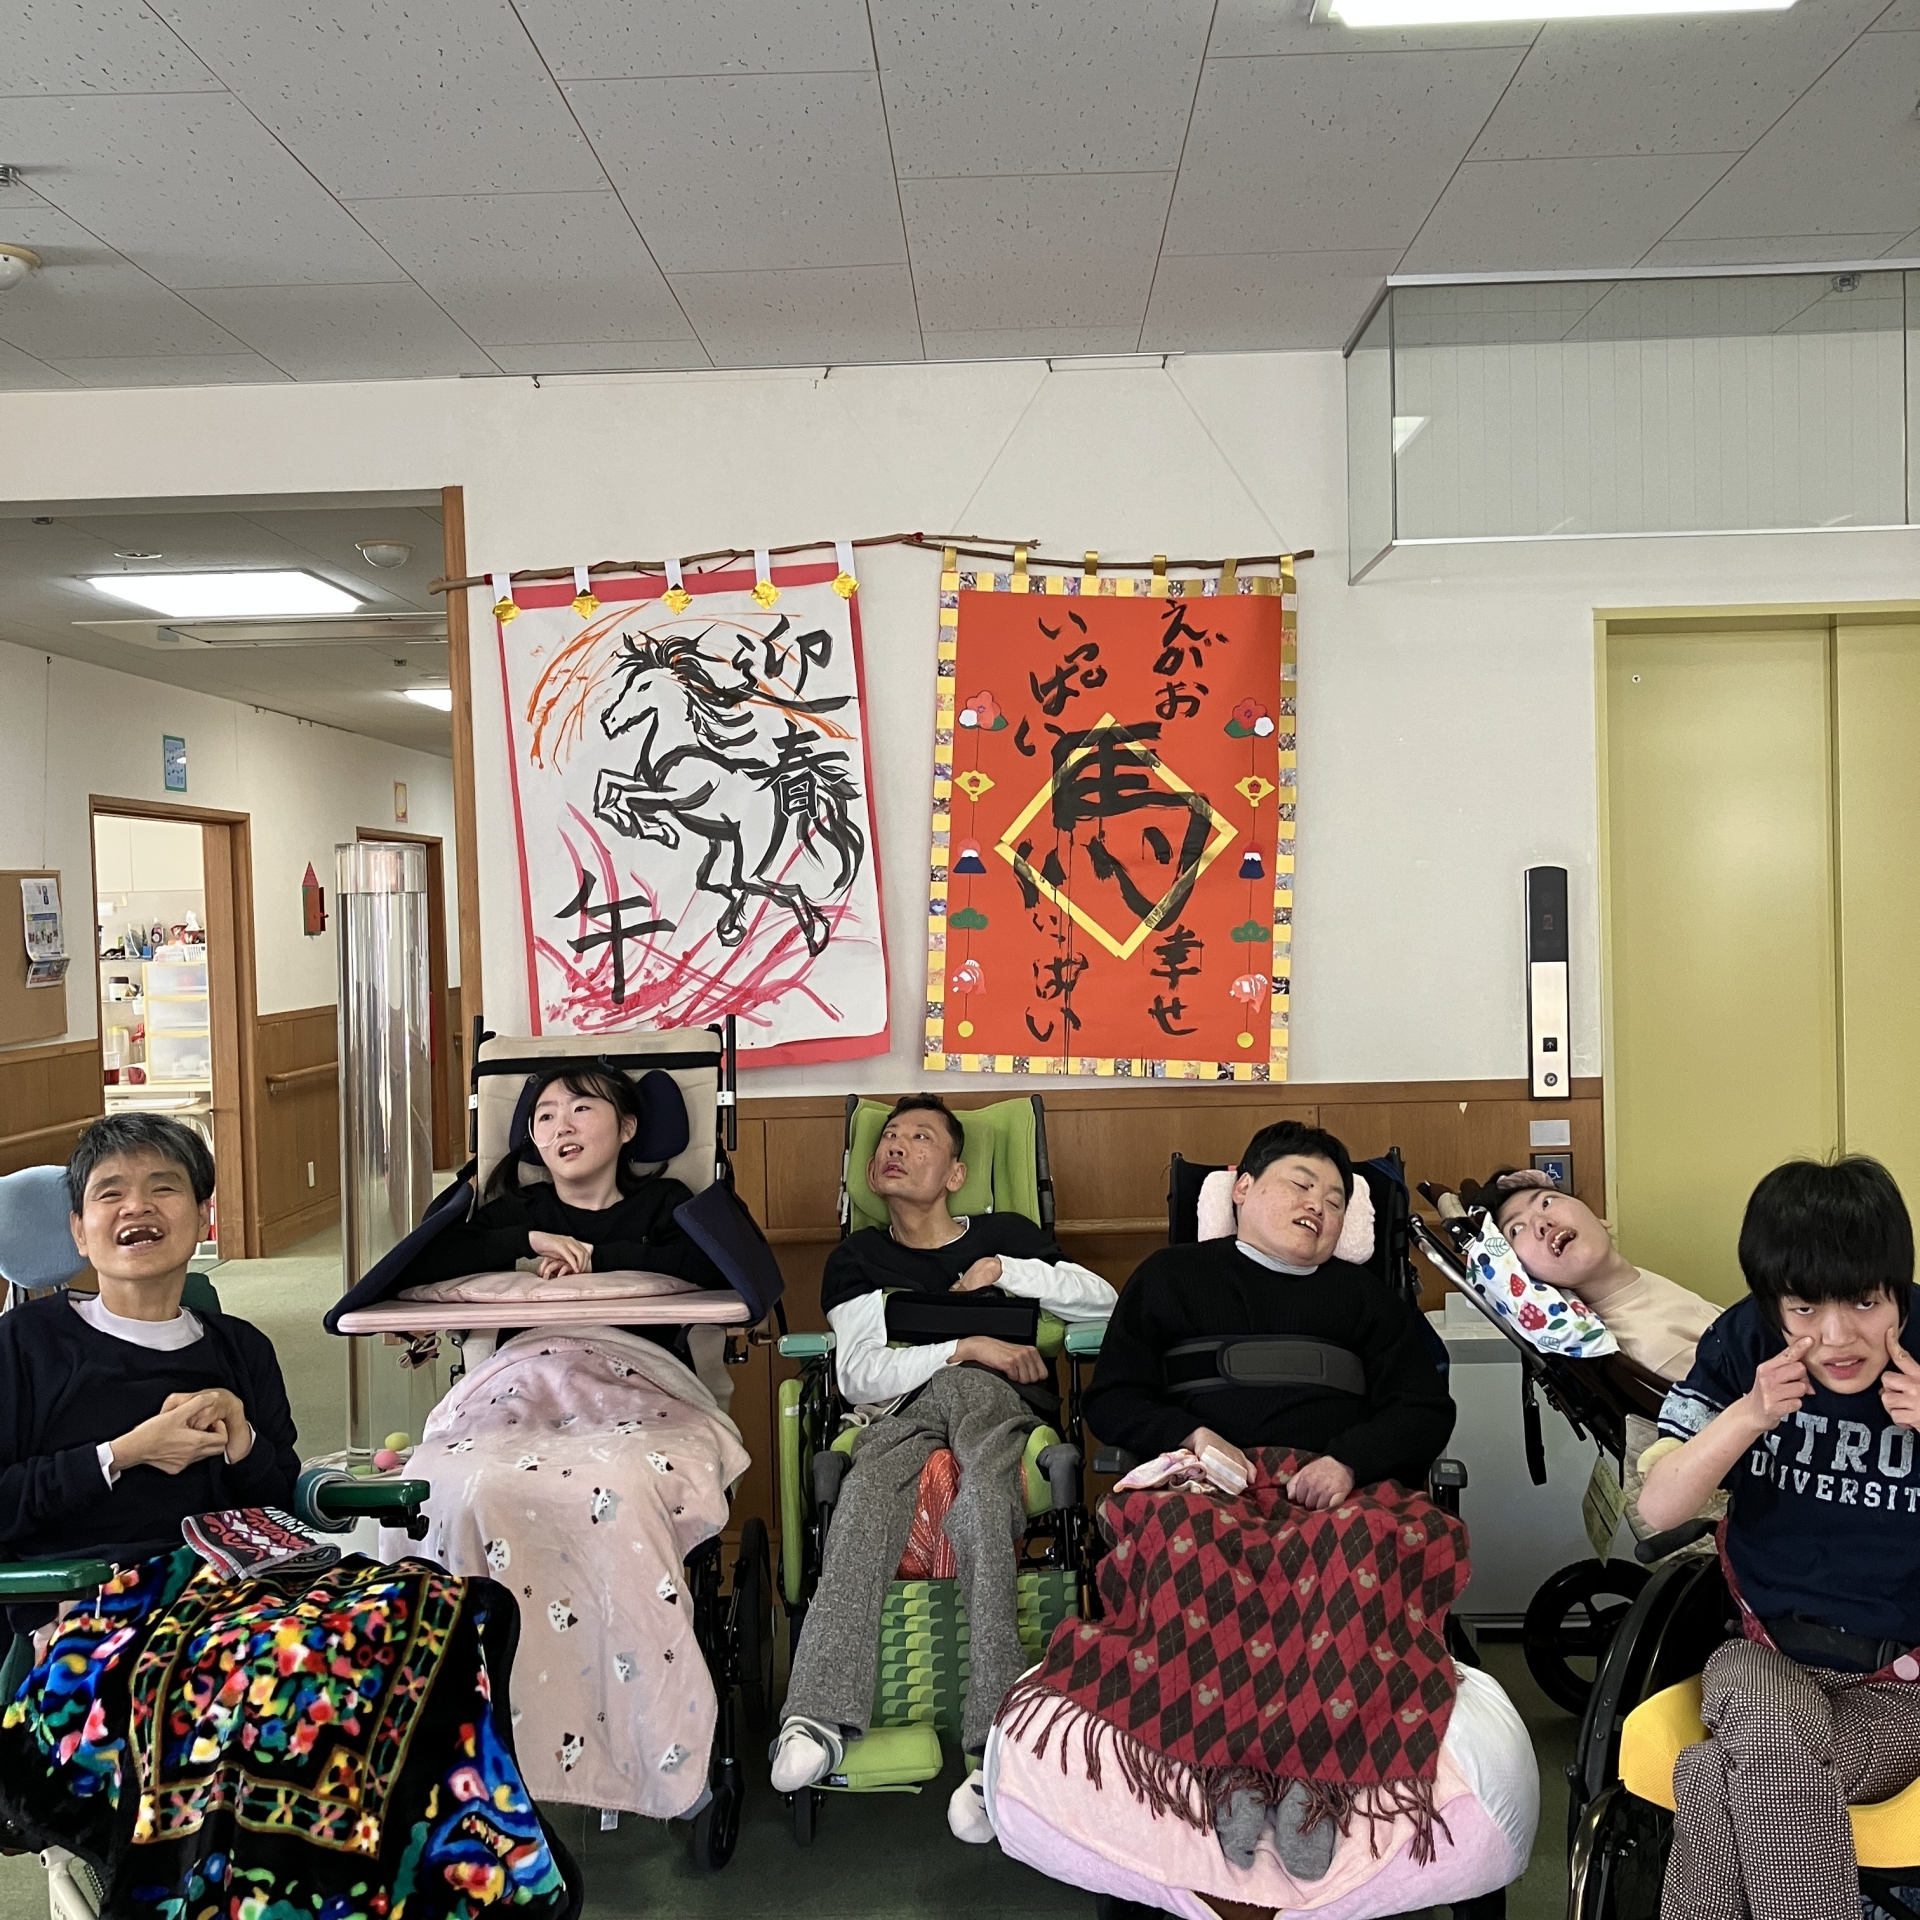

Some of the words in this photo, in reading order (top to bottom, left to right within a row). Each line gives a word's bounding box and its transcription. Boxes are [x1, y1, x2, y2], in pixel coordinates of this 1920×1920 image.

[731, 614, 858, 818] 迎春
[1014, 610, 1108, 757] いっぱい
[1153, 600, 1228, 720] えがお
[1013, 722, 1213, 931] 馬
[553, 868, 678, 1005] 午
[1147, 924, 1204, 1037] 幸せ
